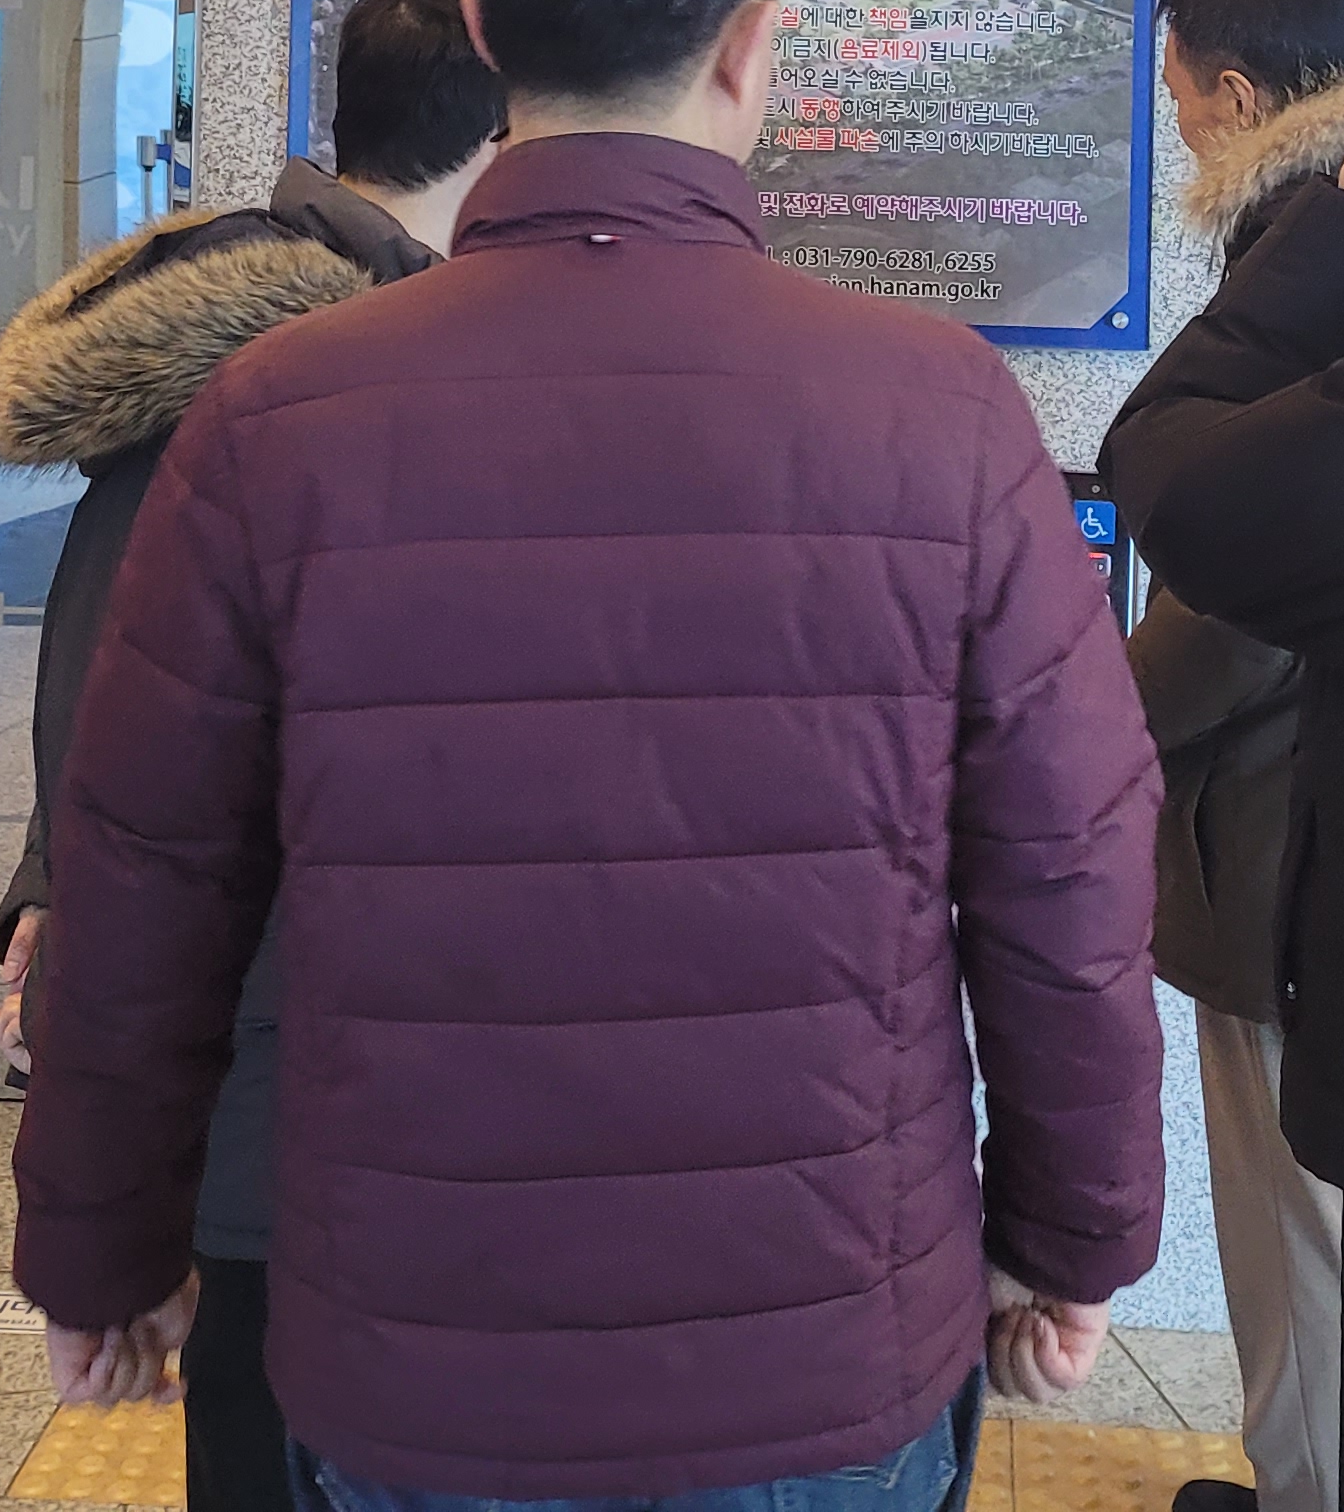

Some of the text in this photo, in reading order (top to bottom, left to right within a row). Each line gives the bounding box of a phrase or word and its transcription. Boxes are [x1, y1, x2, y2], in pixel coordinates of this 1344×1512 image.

[773, 6, 819, 28] 실에
[824, 7, 865, 29] 대한
[974, 10, 1064, 34] 않습니다.
[844, 68, 864, 90] 수
[867, 68, 956, 92] 없습니다.
[799, 96, 882, 123] 동행하여
[885, 98, 947, 124] 주시기
[950, 101, 1040, 127] 바랍니다.
[774, 125, 836, 152] 시설물
[839, 127, 900, 153] 파손에
[903, 130, 944, 155] 주의
[758, 191, 1089, 227] 및 전화로 예약해주시기 바랍니다.
[794, 246, 997, 273] 031-790-6281,6255
